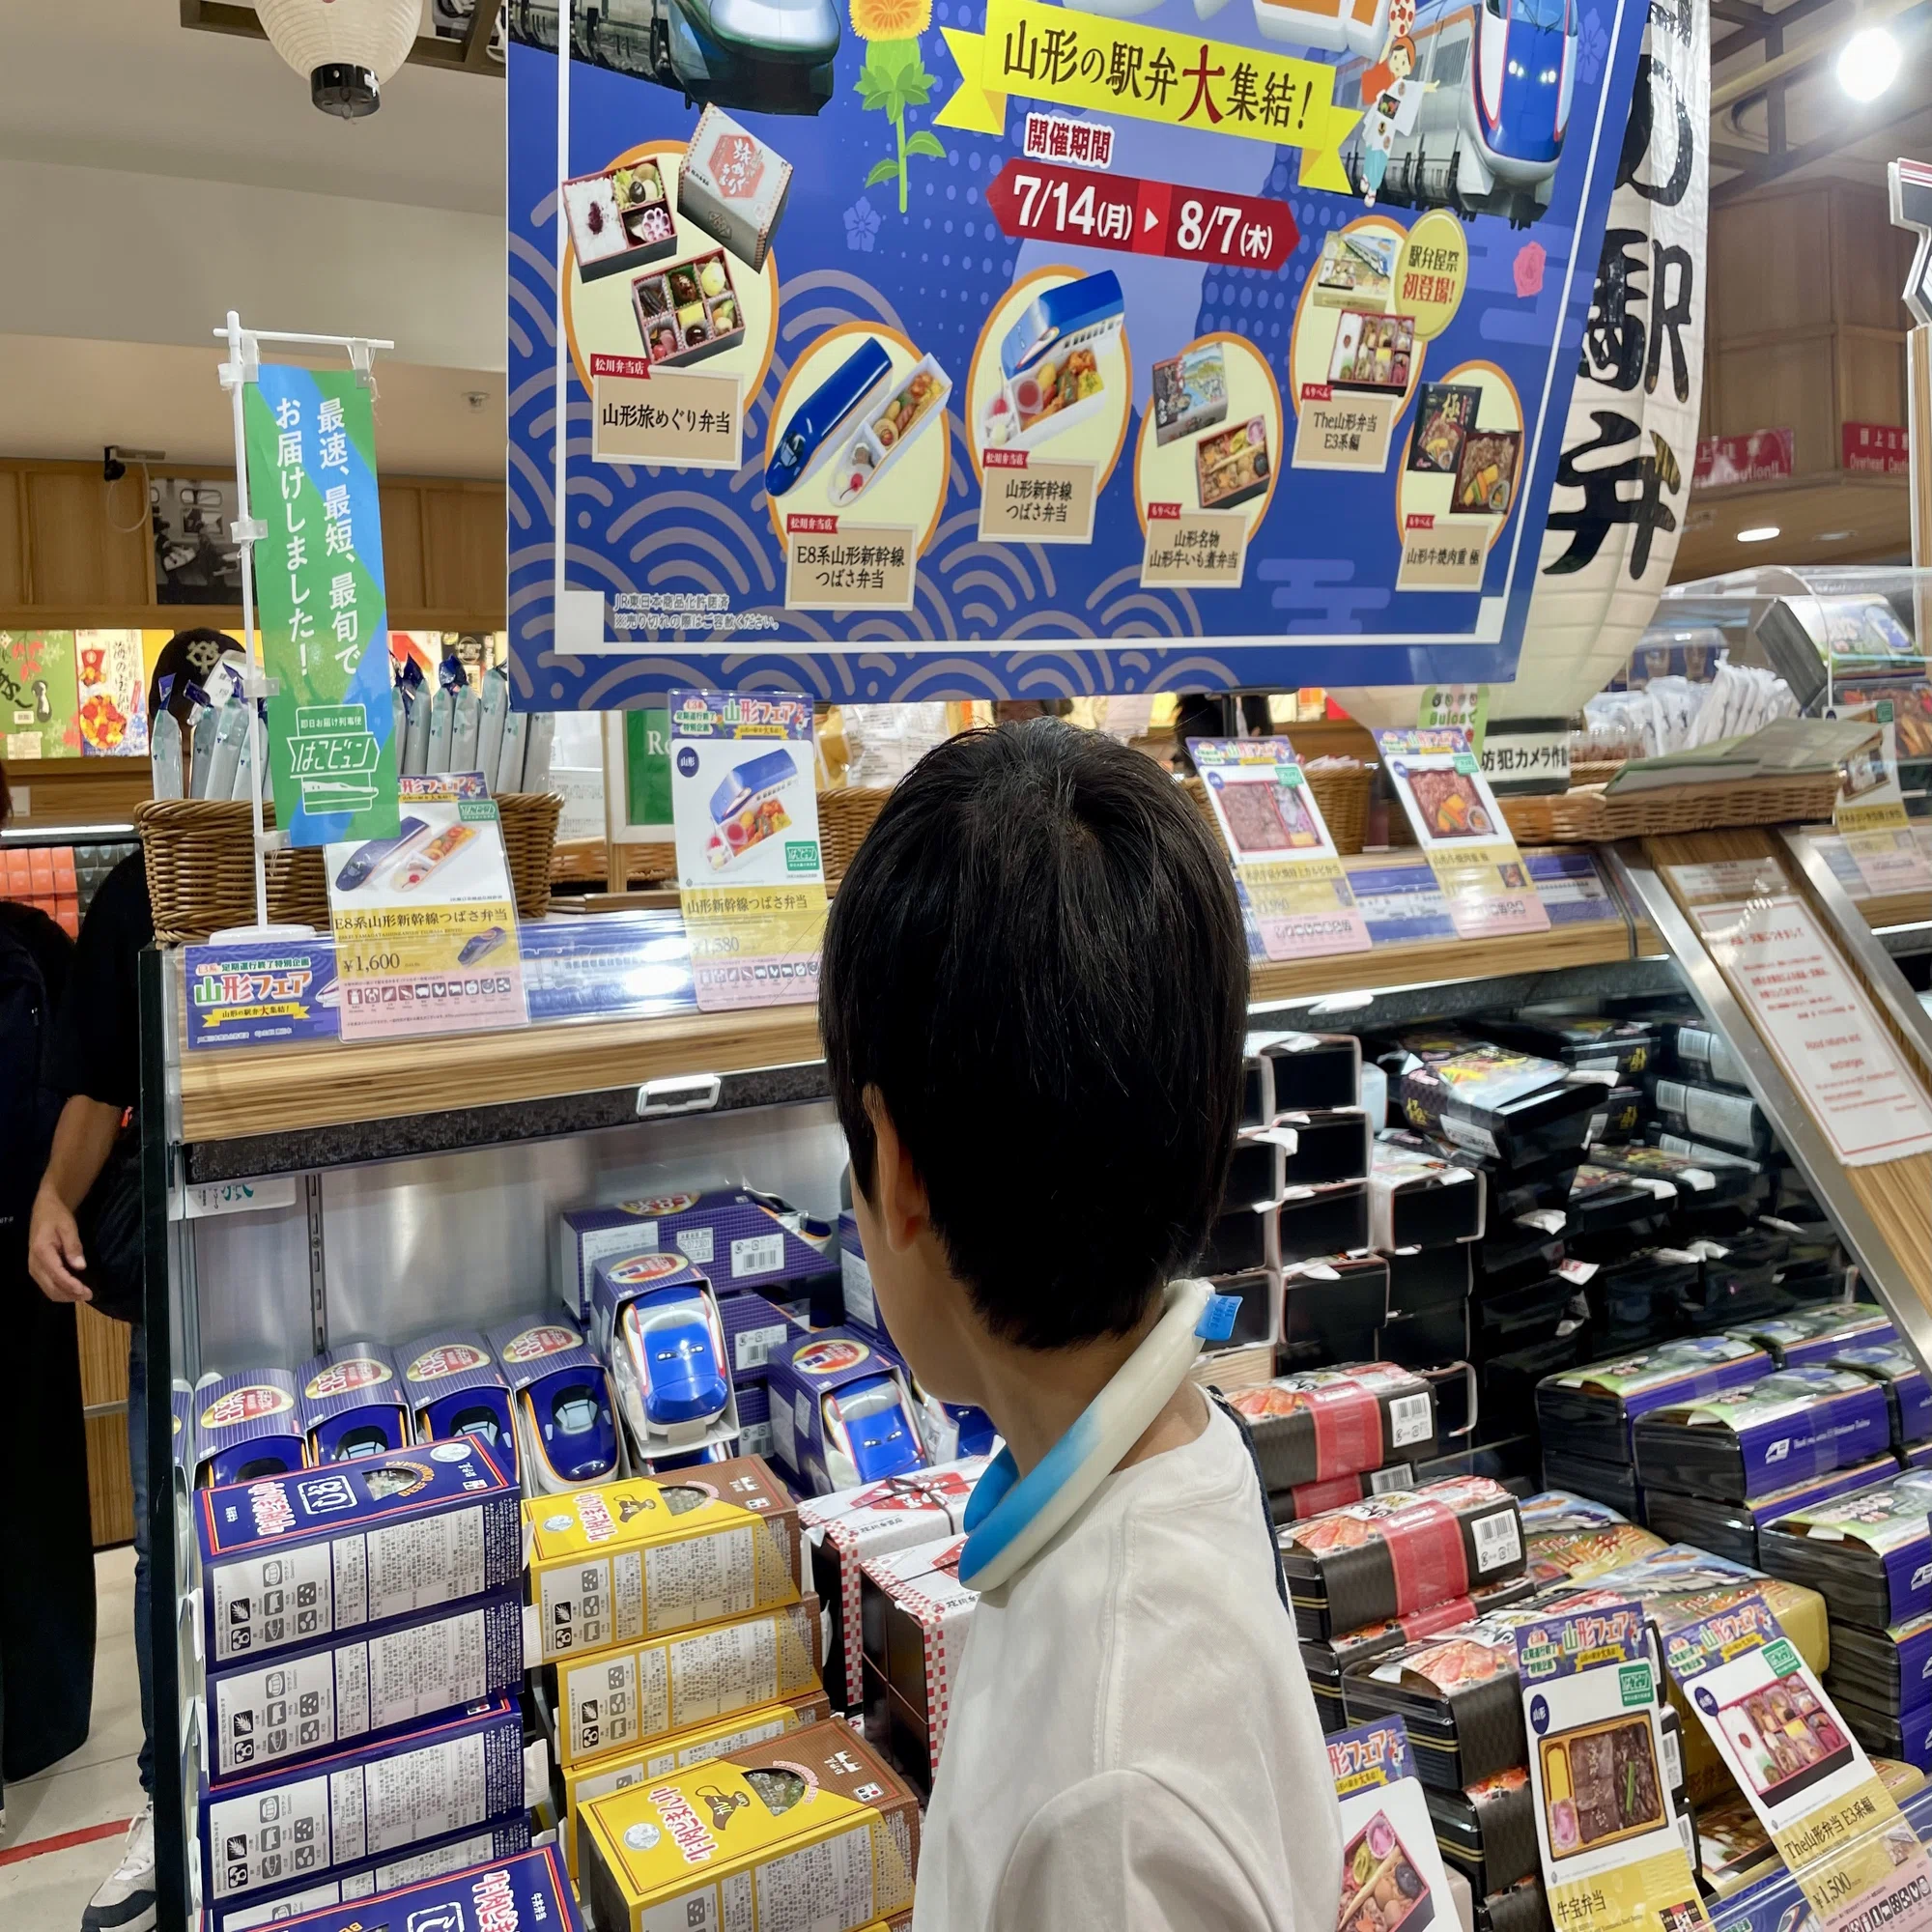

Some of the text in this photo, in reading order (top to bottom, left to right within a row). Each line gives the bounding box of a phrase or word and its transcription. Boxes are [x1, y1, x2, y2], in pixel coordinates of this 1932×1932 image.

[1027, 117, 1112, 163] 開催期間
[1013, 174, 1273, 260] 7/14(月) 8/7(木)
[1407, 244, 1459, 273] 駅弁屋祭
[1403, 271, 1456, 304] 初登場!
[1543, 0, 1692, 580] の駅弁
[595, 357, 644, 375] 松川弁当店
[603, 403, 730, 434] 山形旅めぐり弁当
[1314, 411, 1378, 435] The山形弁当
[1006, 479, 1072, 500] 山形新幹線
[790, 517, 834, 531] 松川弁当店
[1006, 503, 1067, 523] つばさ弁当
[275, 397, 316, 676] お届けしました!
[317, 397, 360, 675] 最速、最短、最旬で
[1174, 529, 1220, 549] 山形名物
[797, 545, 905, 567] E8系山形新幹線
[816, 568, 885, 589] つばさ弁当
[724, 698, 795, 724] 山形フェア
[297, 737, 371, 772] はこビュン
[334, 908, 508, 930] E8系山形新幹線つばさ弁当
[687, 895, 808, 914] 山形新幹線つばさ弁当
[343, 952, 401, 973] ¥1,600
[195, 971, 311, 1005] 山形フェア
[247, 1481, 297, 1536] 牛肉どまん中
[1563, 1612, 1629, 1652] 山形フェア
[1327, 1730, 1385, 1776] 形フェア
[712, 1796, 734, 1817] カレー
[650, 1786, 719, 1863] 牛肉どまん中
[1784, 1817, 1845, 1860] The山形弁当
[1841, 1796, 1877, 1826] E3系編
[1556, 1889, 1606, 1922] 牛宝弁当
[1813, 1871, 1852, 1909] ¥1,500
